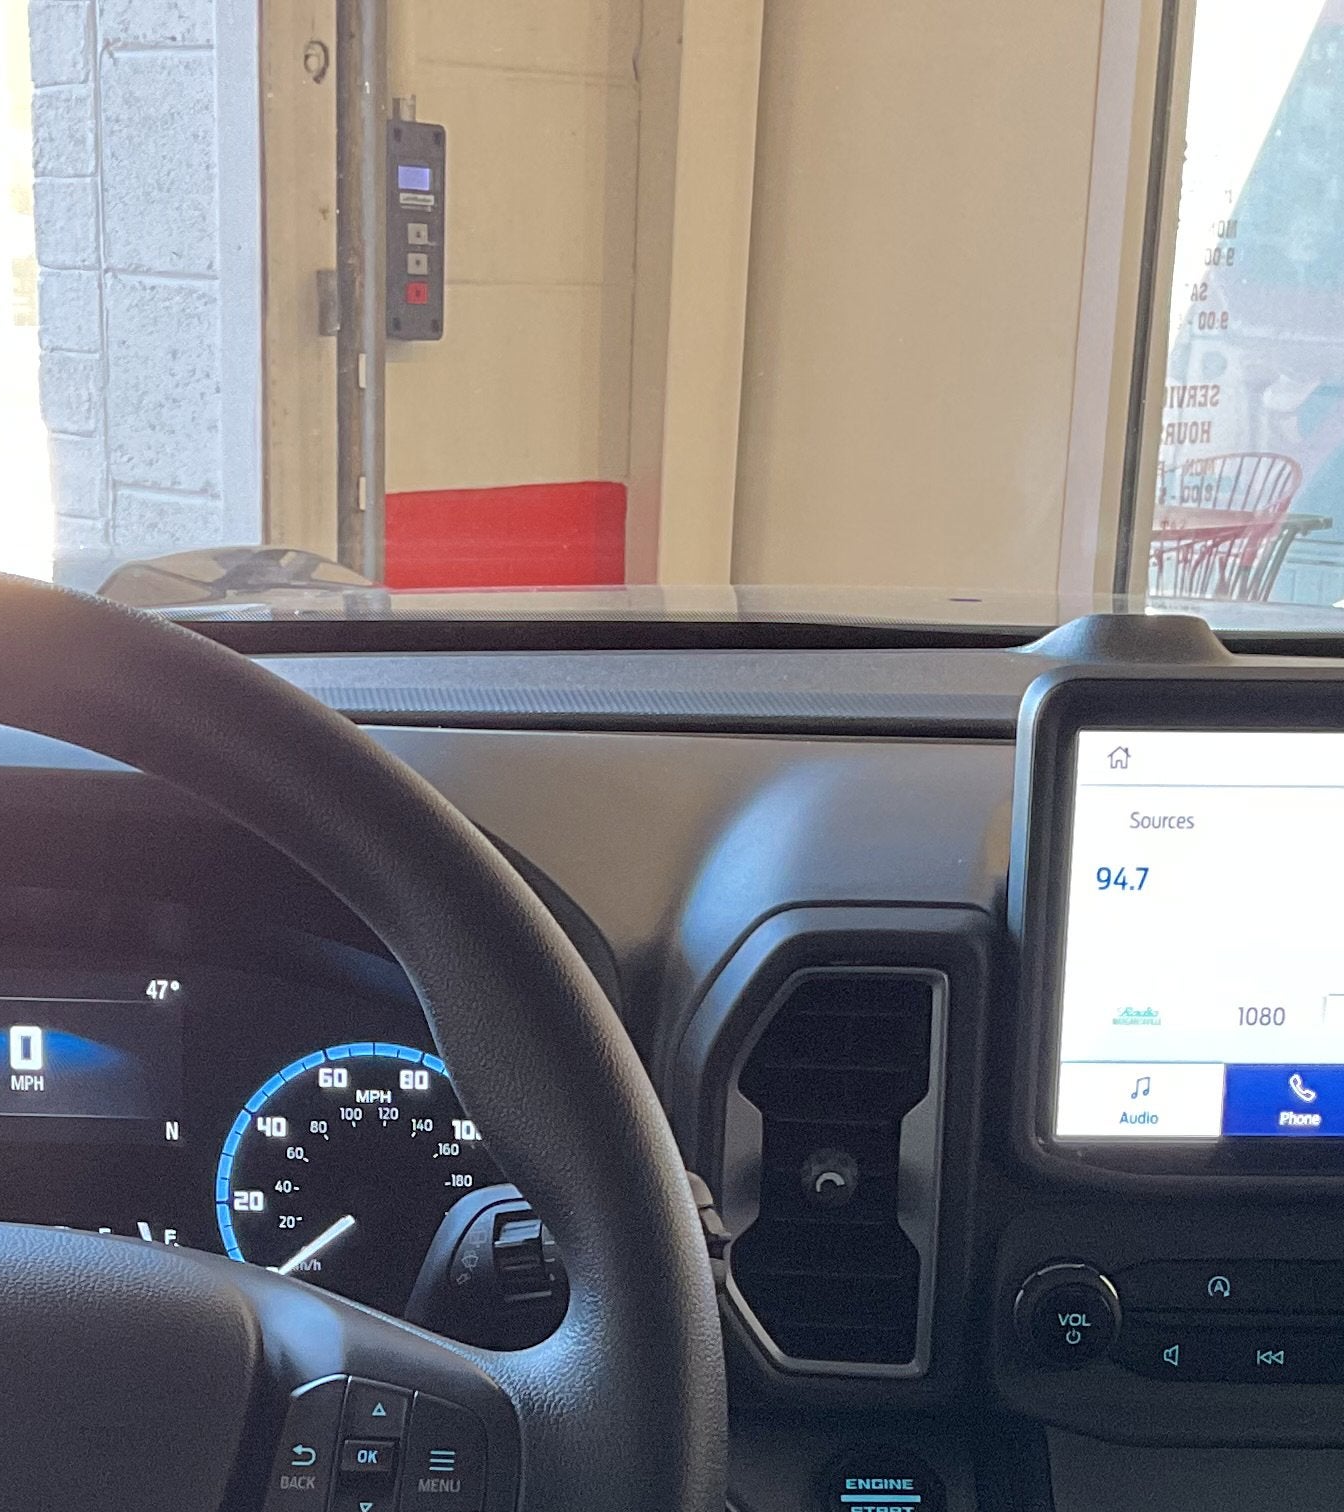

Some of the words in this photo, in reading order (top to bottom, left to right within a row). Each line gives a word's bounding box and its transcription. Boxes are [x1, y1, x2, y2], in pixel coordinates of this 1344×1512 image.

[1130, 812, 1194, 829] Sources
[1097, 867, 1149, 890] 94.7
[1239, 1007, 1285, 1026] 1080
[10, 1024, 43, 1070] 0
[11, 1075, 44, 1092] MPH
[319, 1068, 347, 1088] 60
[400, 1070, 428, 1090] 80
[356, 1090, 391, 1103] MPH
[339, 1108, 362, 1121] 100
[377, 1108, 399, 1120] 120
[1120, 1112, 1158, 1124] Audio
[1279, 1112, 1321, 1126] Phone
[166, 1122, 178, 1140] N
[257, 1117, 286, 1137] 40
[310, 1121, 327, 1134] 80
[411, 1119, 433, 1132] 140
[287, 1147, 303, 1160] 60
[438, 1143, 459, 1156] 160
[275, 1181, 292, 1193] 40
[451, 1175, 473, 1187] 180
[234, 1191, 264, 1211] 20
[279, 1215, 295, 1228] 20
[1058, 1314, 1091, 1329] VOL
[358, 1450, 377, 1463] OK
[280, 1476, 316, 1489] BACK
[418, 1479, 461, 1493] MENU
[846, 1479, 914, 1490] ENGINE
